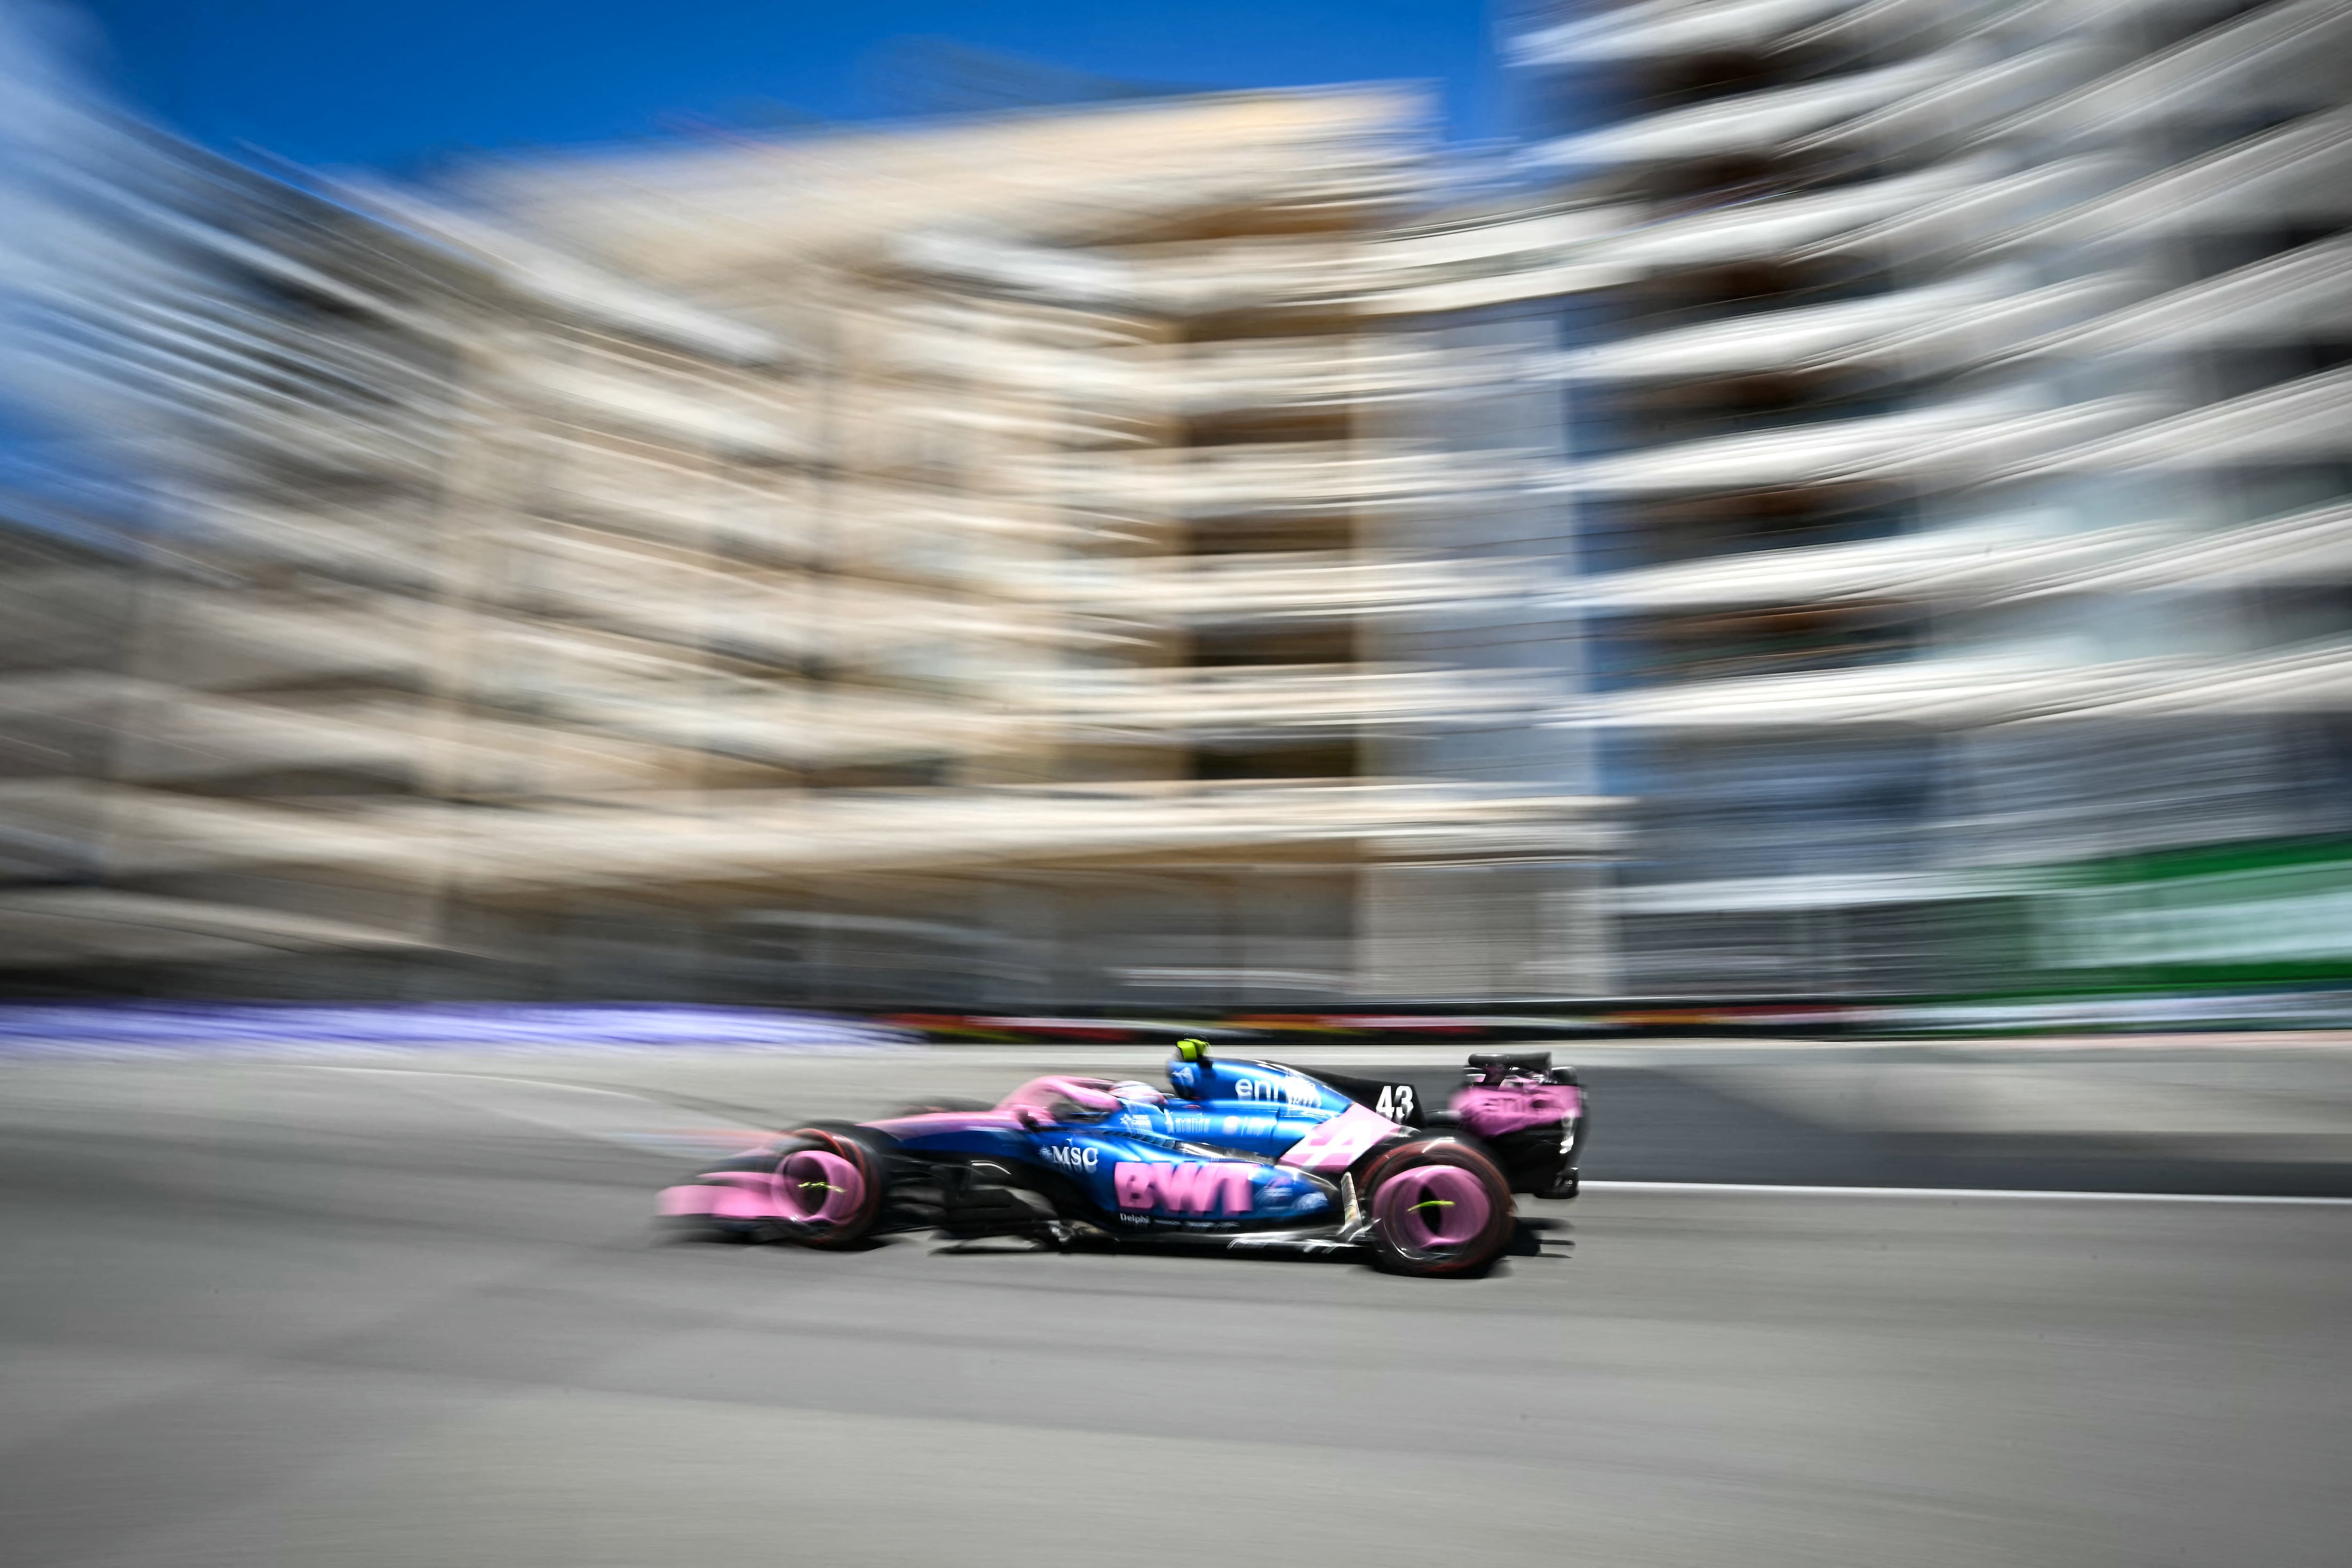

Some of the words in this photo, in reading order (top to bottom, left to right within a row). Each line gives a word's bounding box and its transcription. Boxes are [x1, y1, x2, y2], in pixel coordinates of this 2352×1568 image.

[1375, 1085, 1414, 1119] 43
[1051, 1146, 1098, 1166] MSC
[1114, 1162, 1260, 1213] BWT
[1120, 1213, 1151, 1224] Delphi
